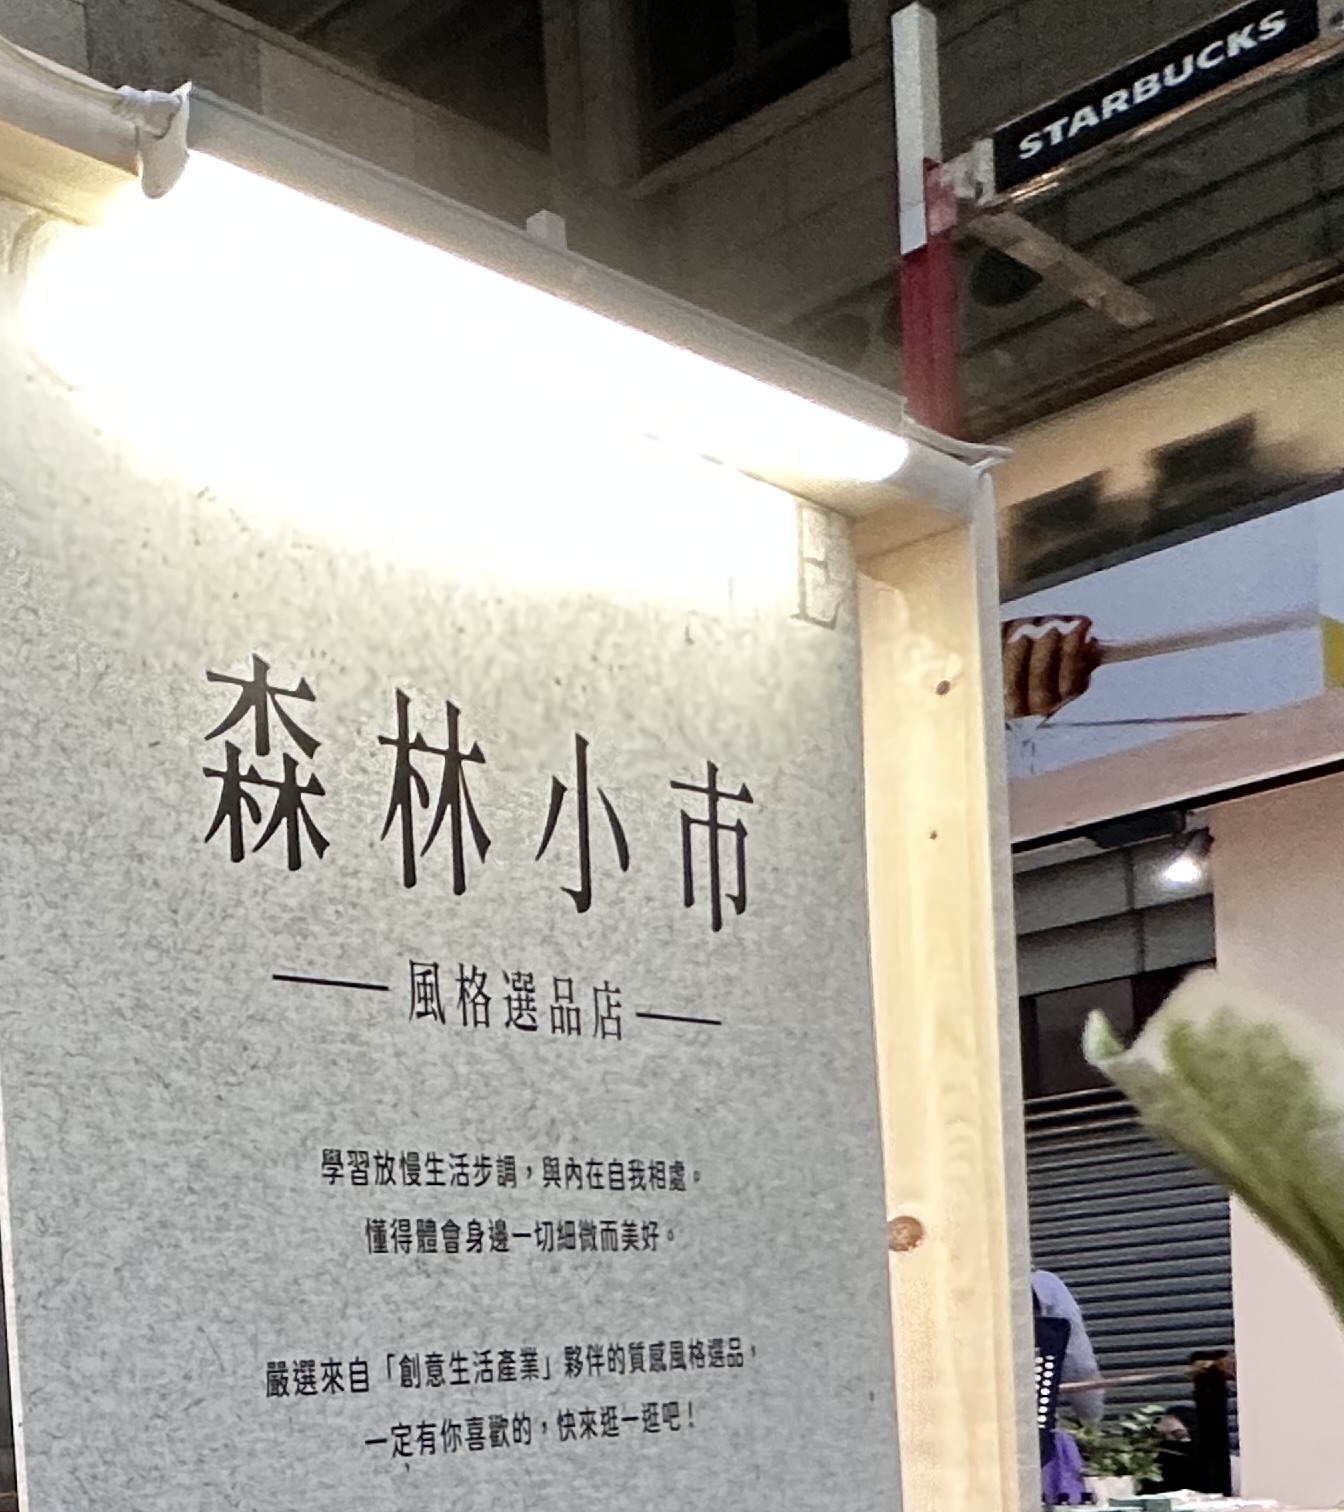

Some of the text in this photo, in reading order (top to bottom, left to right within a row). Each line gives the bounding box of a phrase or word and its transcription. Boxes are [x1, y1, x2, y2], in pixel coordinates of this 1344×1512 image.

[1018, 9, 1289, 160] STARBUCKS
[202, 653, 755, 933] 森林小市
[408, 960, 624, 1041] 風格選品店
